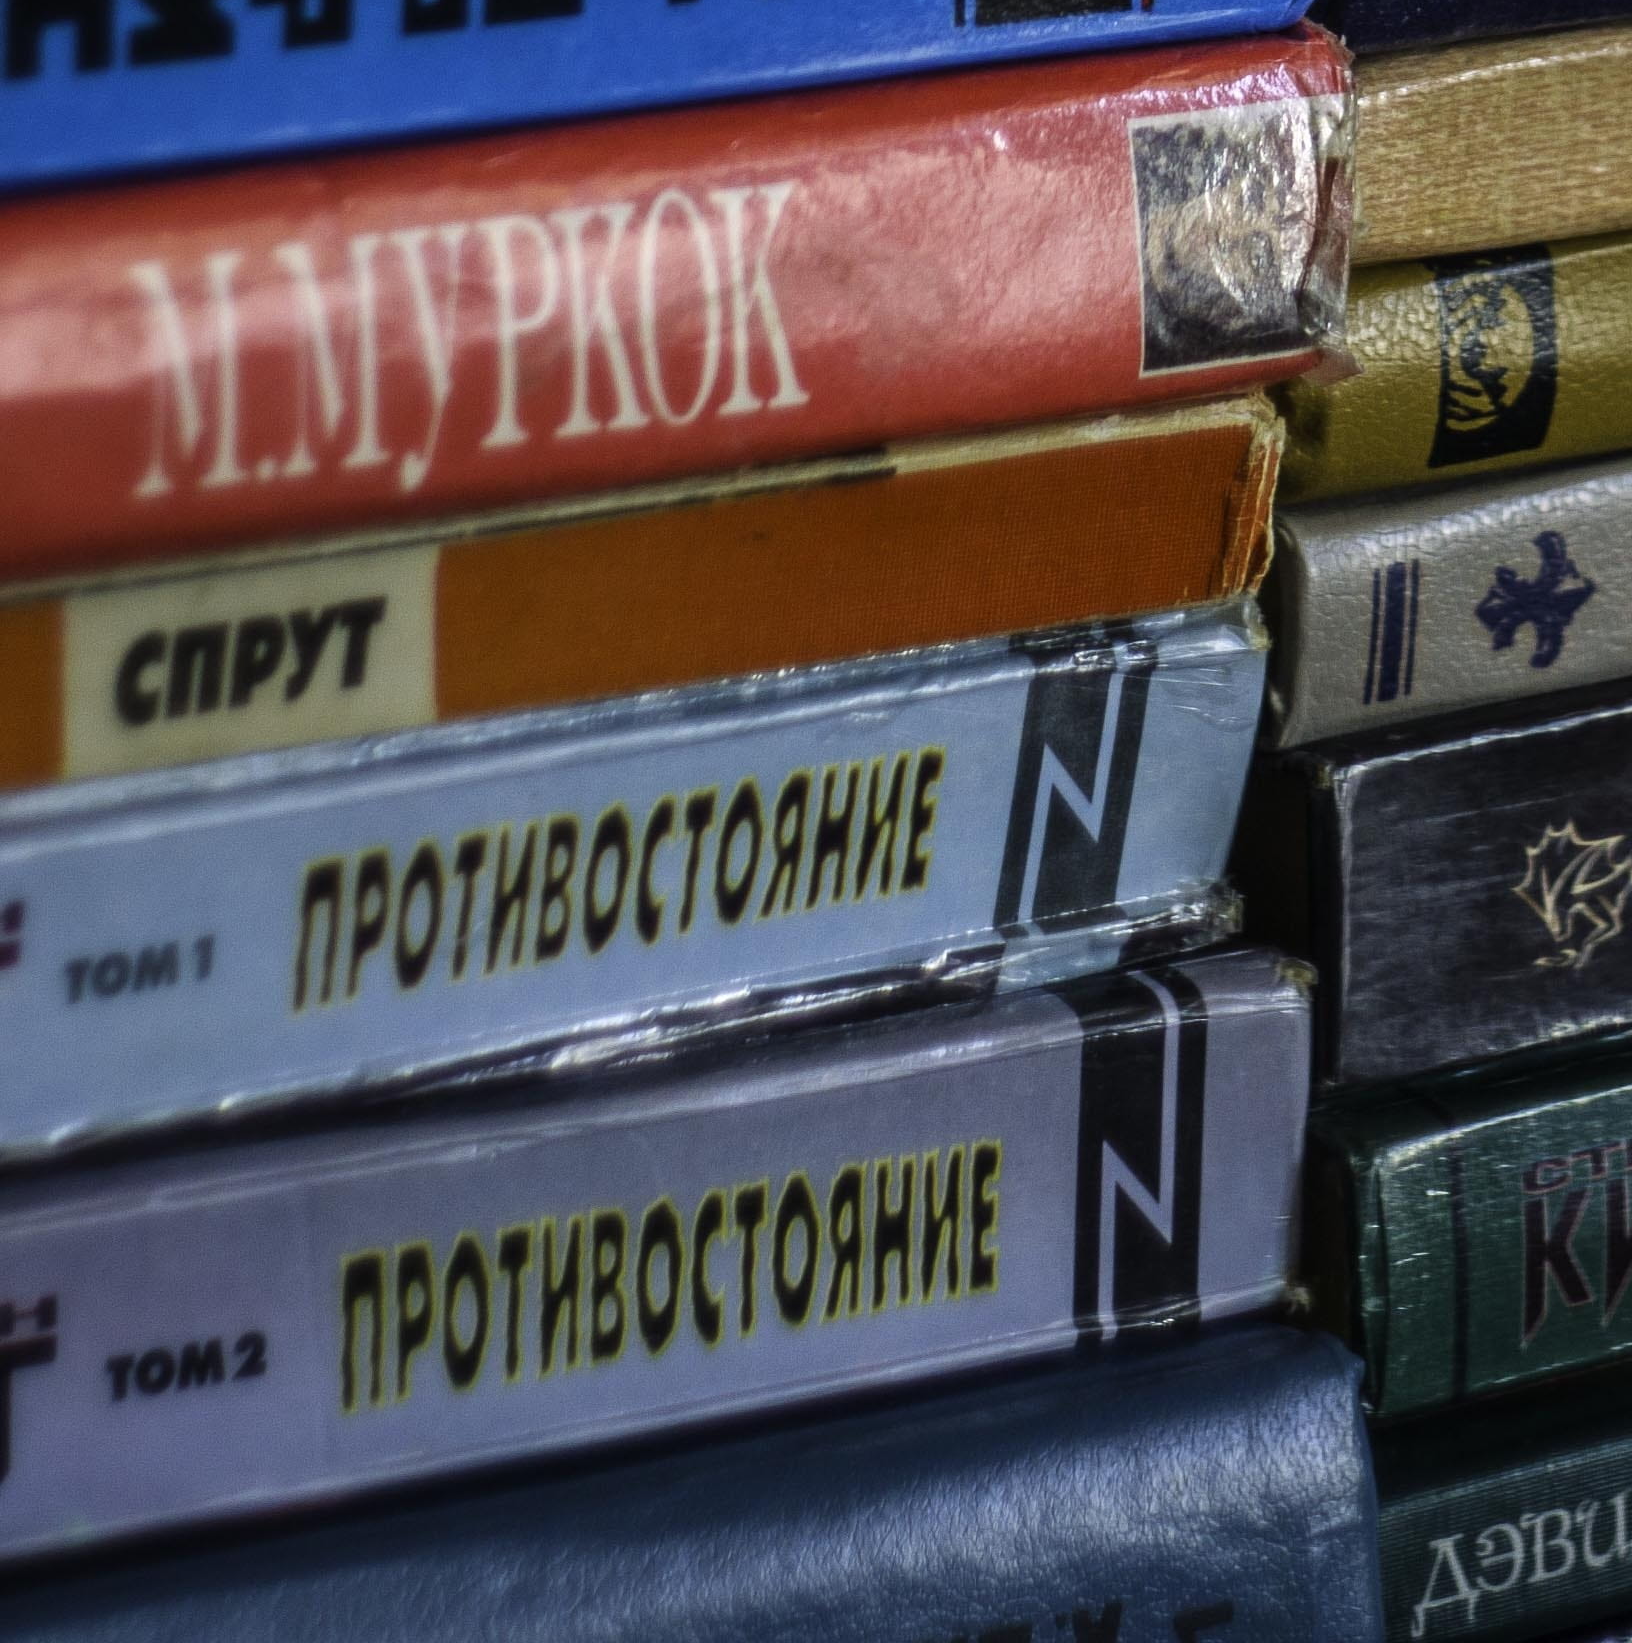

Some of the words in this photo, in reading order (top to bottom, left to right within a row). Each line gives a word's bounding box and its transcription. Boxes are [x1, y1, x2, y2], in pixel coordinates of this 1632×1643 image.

[113, 596, 388, 723] СПРУТ
[64, 940, 180, 1005] ТОМ
[290, 746, 946, 1013] ПРОТИВОСТОЯНИЕ
[105, 1337, 225, 1403] ТОМ
[233, 1331, 268, 1379] 2
[339, 1136, 1004, 1414] ПРОТИВОСТОЯНИЕ
